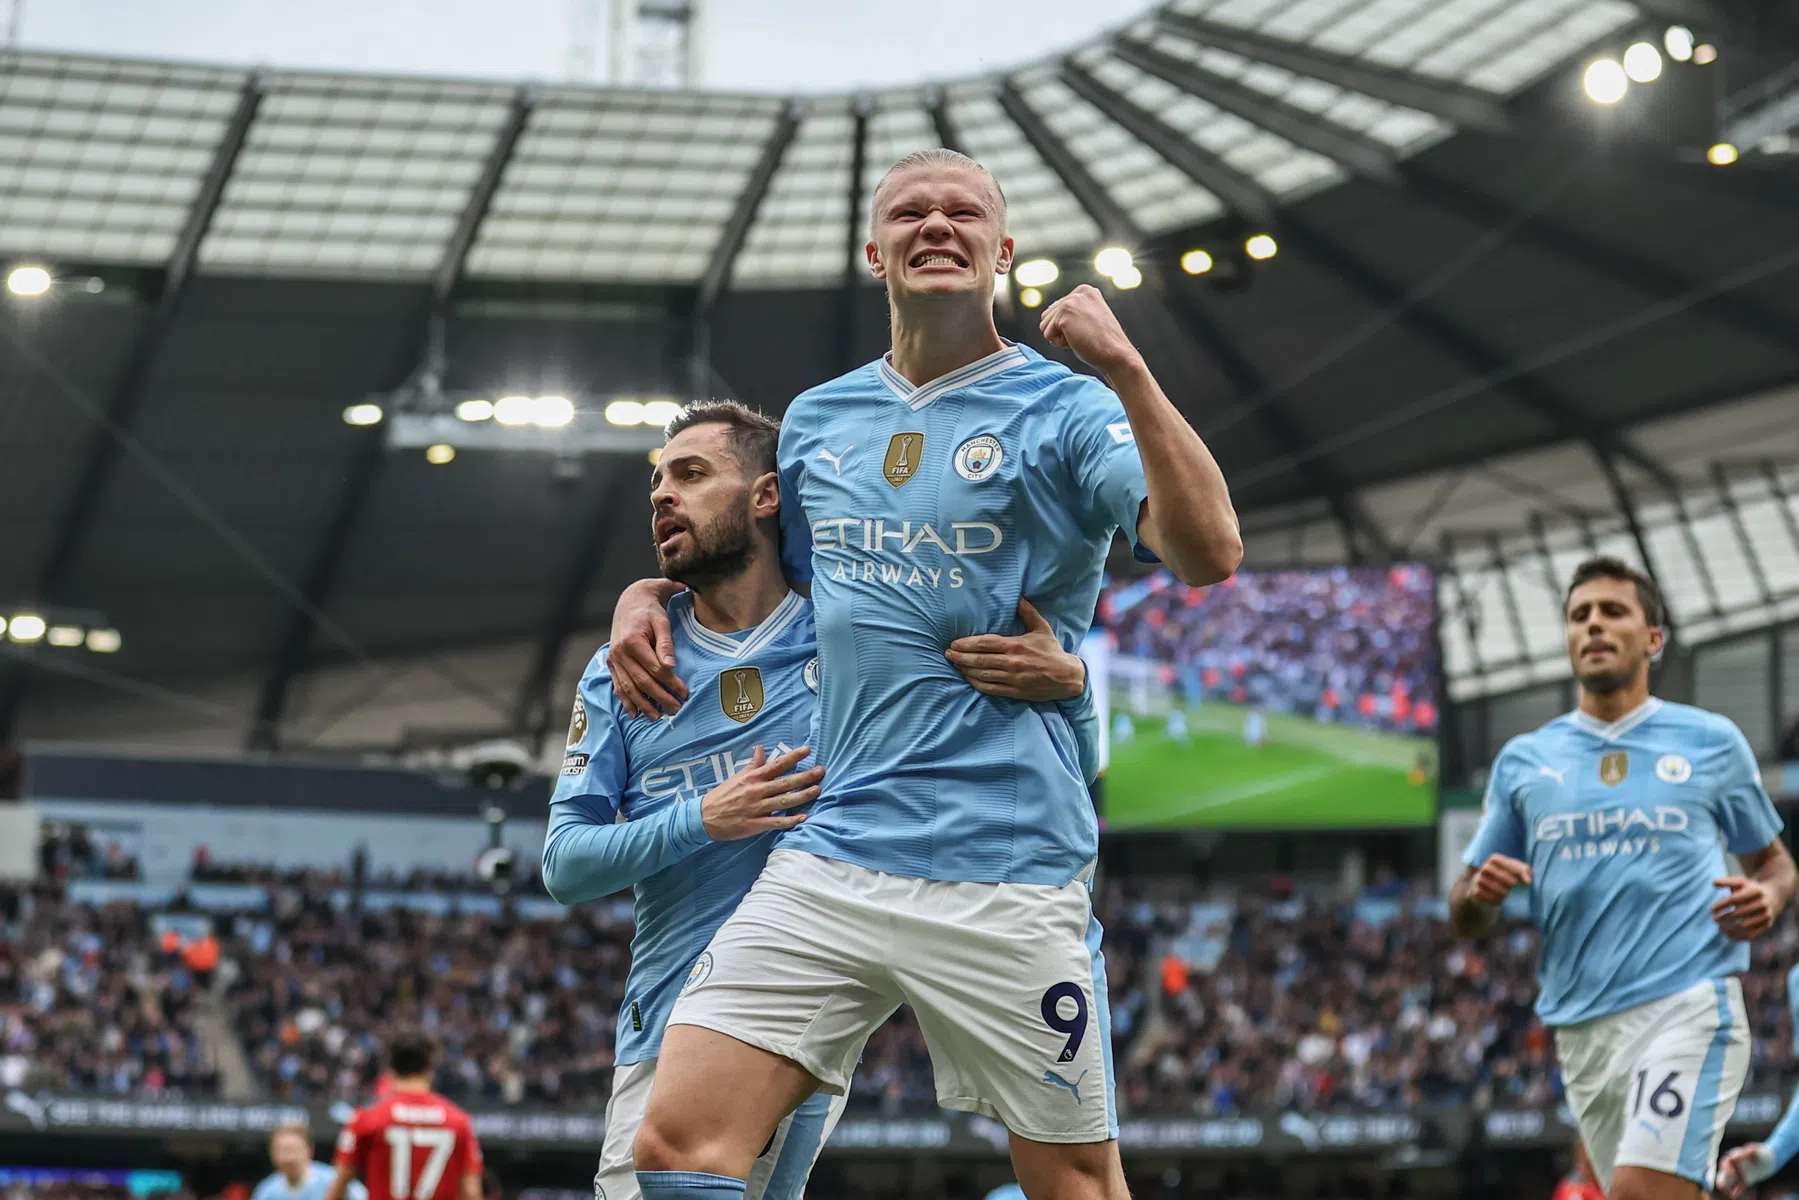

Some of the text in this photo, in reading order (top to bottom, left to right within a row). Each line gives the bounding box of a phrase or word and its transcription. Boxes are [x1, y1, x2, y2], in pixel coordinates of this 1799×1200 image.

[961, 437, 1001, 453] MANCHESTER
[891, 466, 909, 474] FIFA
[812, 518, 1003, 555] ETIHAD
[831, 560, 965, 589] AIRWAYS
[734, 703, 753, 713] FIFA
[1536, 805, 1688, 841] ETIHAD
[1559, 836, 1661, 861] AIRWAYS
[1041, 981, 1088, 1063] 9
[1633, 1070, 1685, 1119] 16
[385, 1125, 456, 1200] 17
